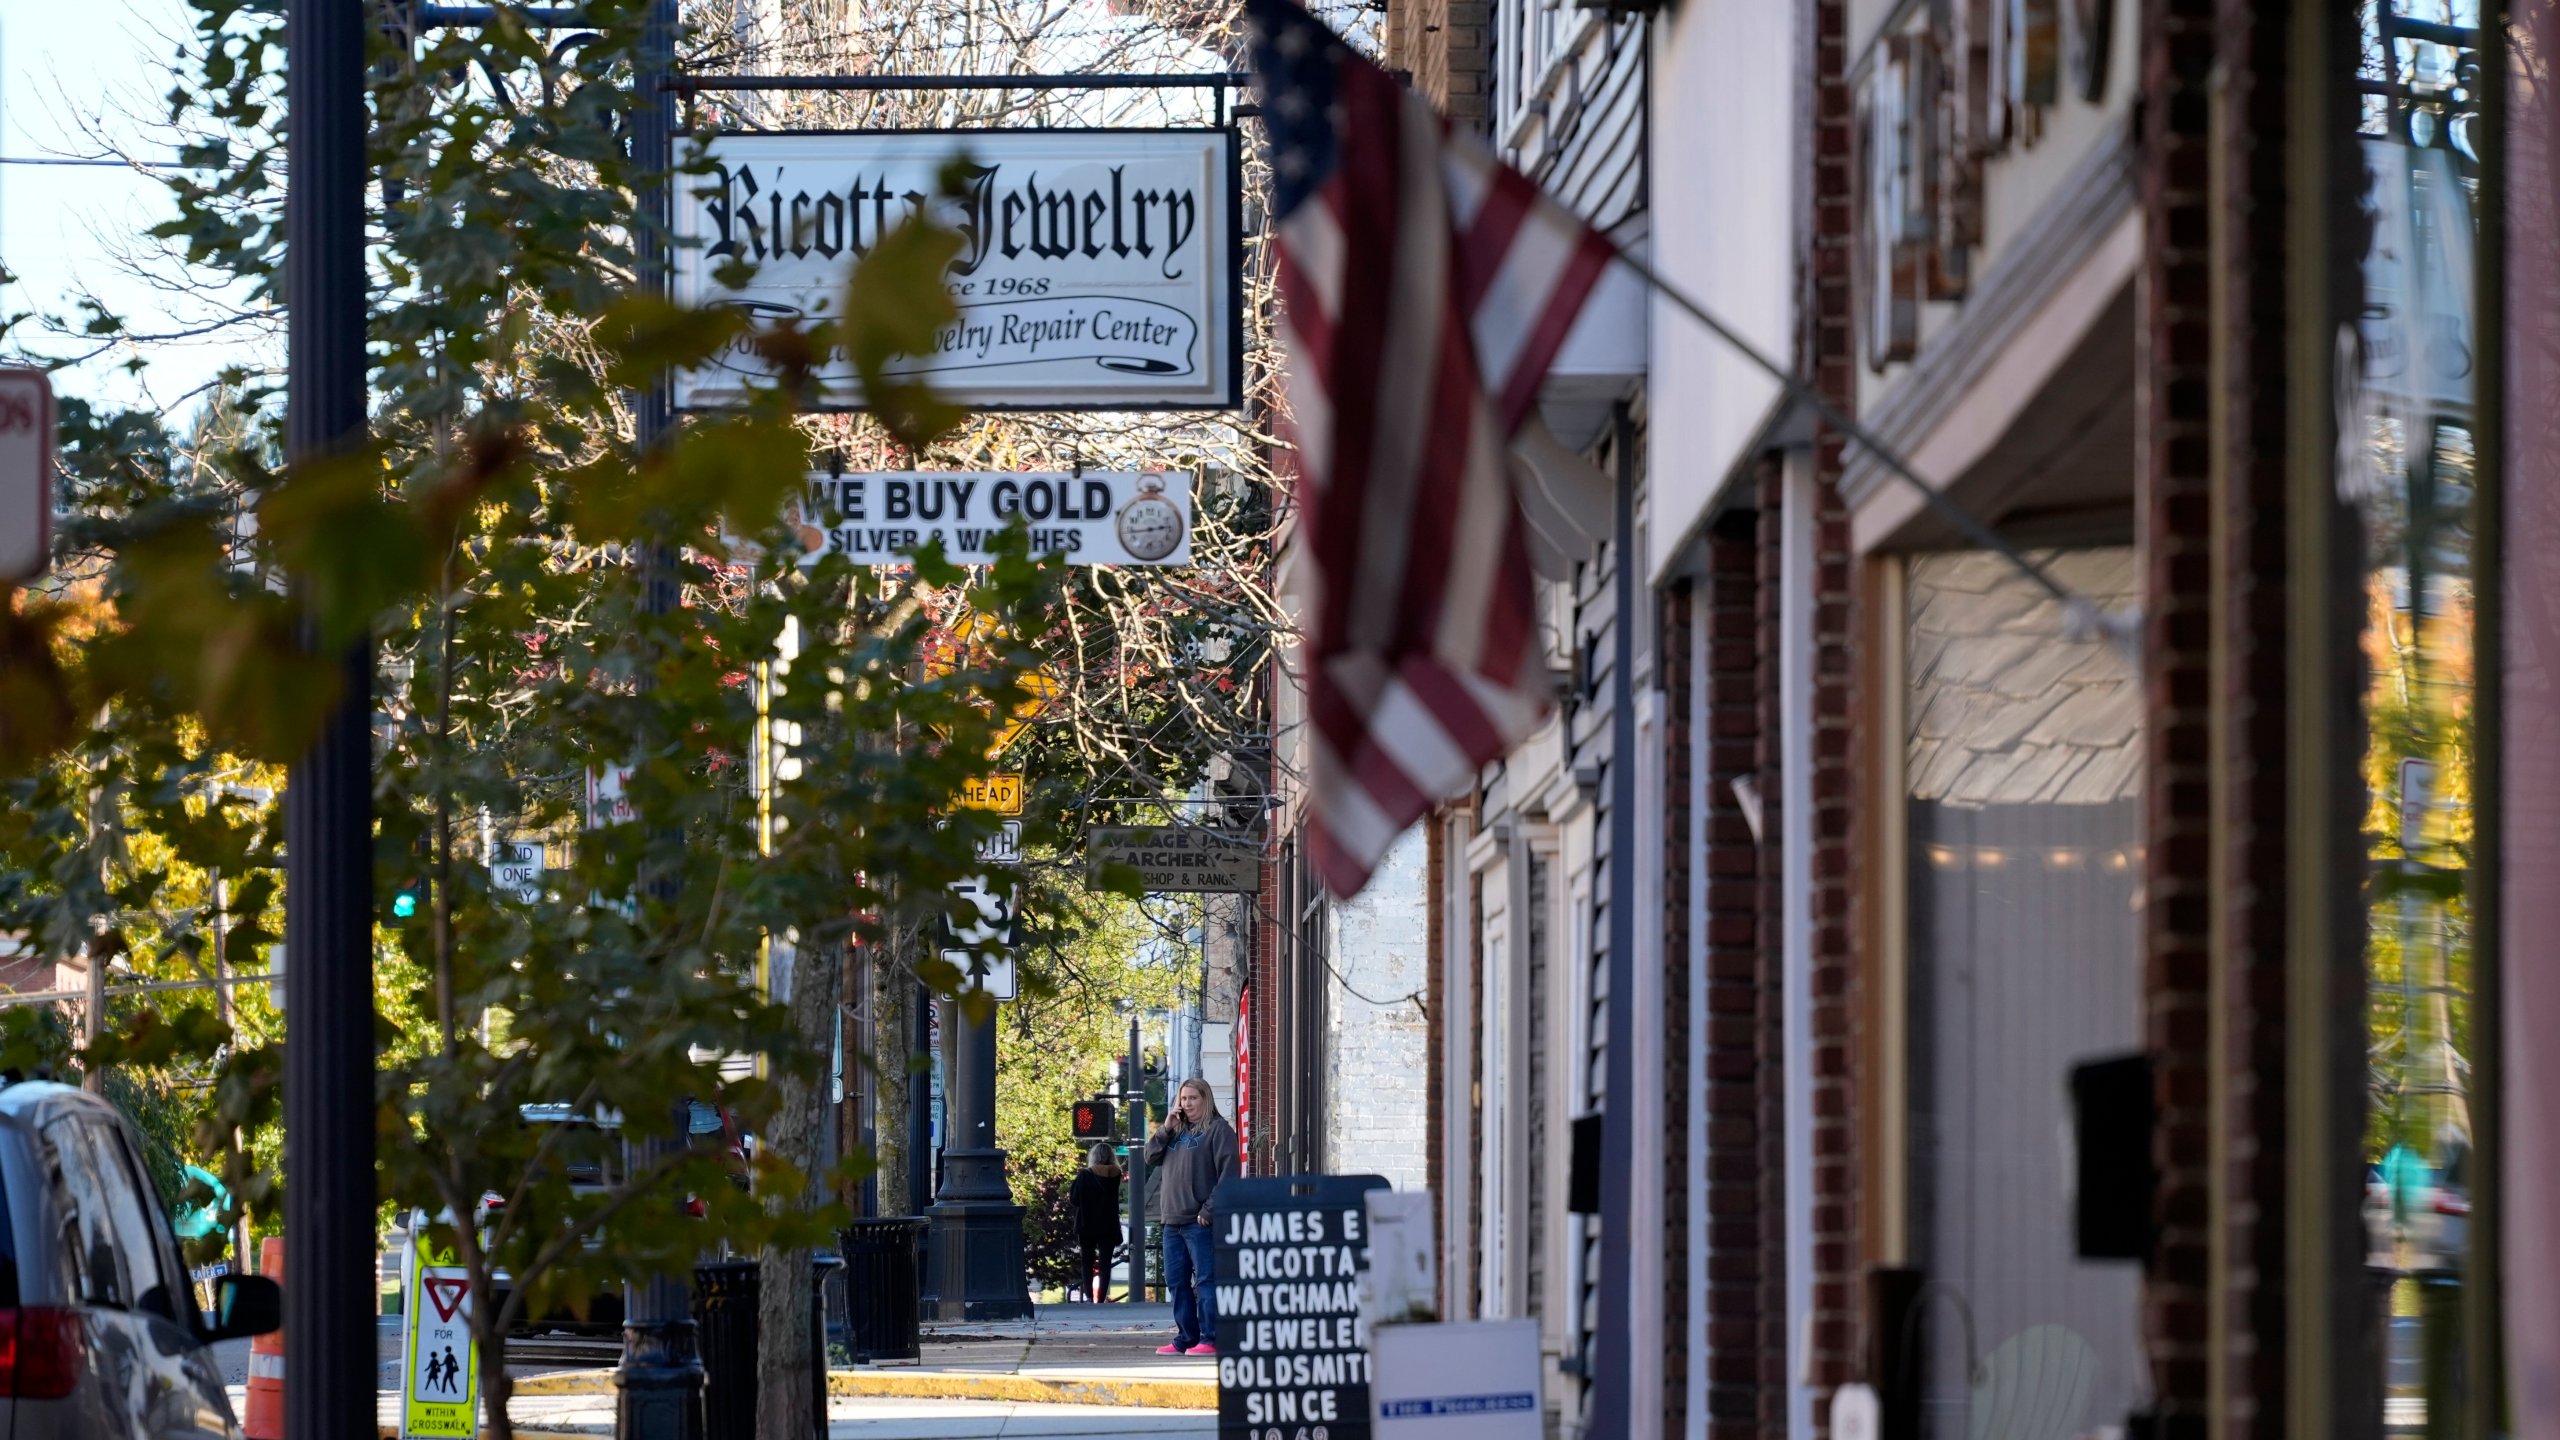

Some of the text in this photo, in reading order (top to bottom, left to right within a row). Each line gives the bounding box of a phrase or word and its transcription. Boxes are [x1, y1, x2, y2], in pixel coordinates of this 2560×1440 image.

[945, 163, 1196, 279] Jewelry
[983, 278, 1051, 295] 1968
[932, 309, 1179, 359] welry Repair Center
[803, 477, 1113, 523] WE BUY GOLD
[829, 527, 1083, 553] SILVER & WHES
[951, 786, 1012, 802] AHEAD
[976, 832, 1015, 855] UTH
[1126, 851, 1222, 868] ARCHERY
[502, 867, 533, 882] ONE
[1144, 872, 1237, 886] SHOP & RANGE
[1225, 1210, 1360, 1244] JAMES E
[1238, 1246, 1356, 1280] RICOTTA
[1215, 1282, 1361, 1317] WATCHMAK
[434, 1329, 453, 1340] FOR
[1239, 1317, 1364, 1352] JEWELE
[1219, 1353, 1372, 1389] GOLDSMIT
[425, 1407, 456, 1417] WITHIN
[1246, 1389, 1338, 1424] SINCE
[412, 1419, 466, 1431] CROSSWALK
